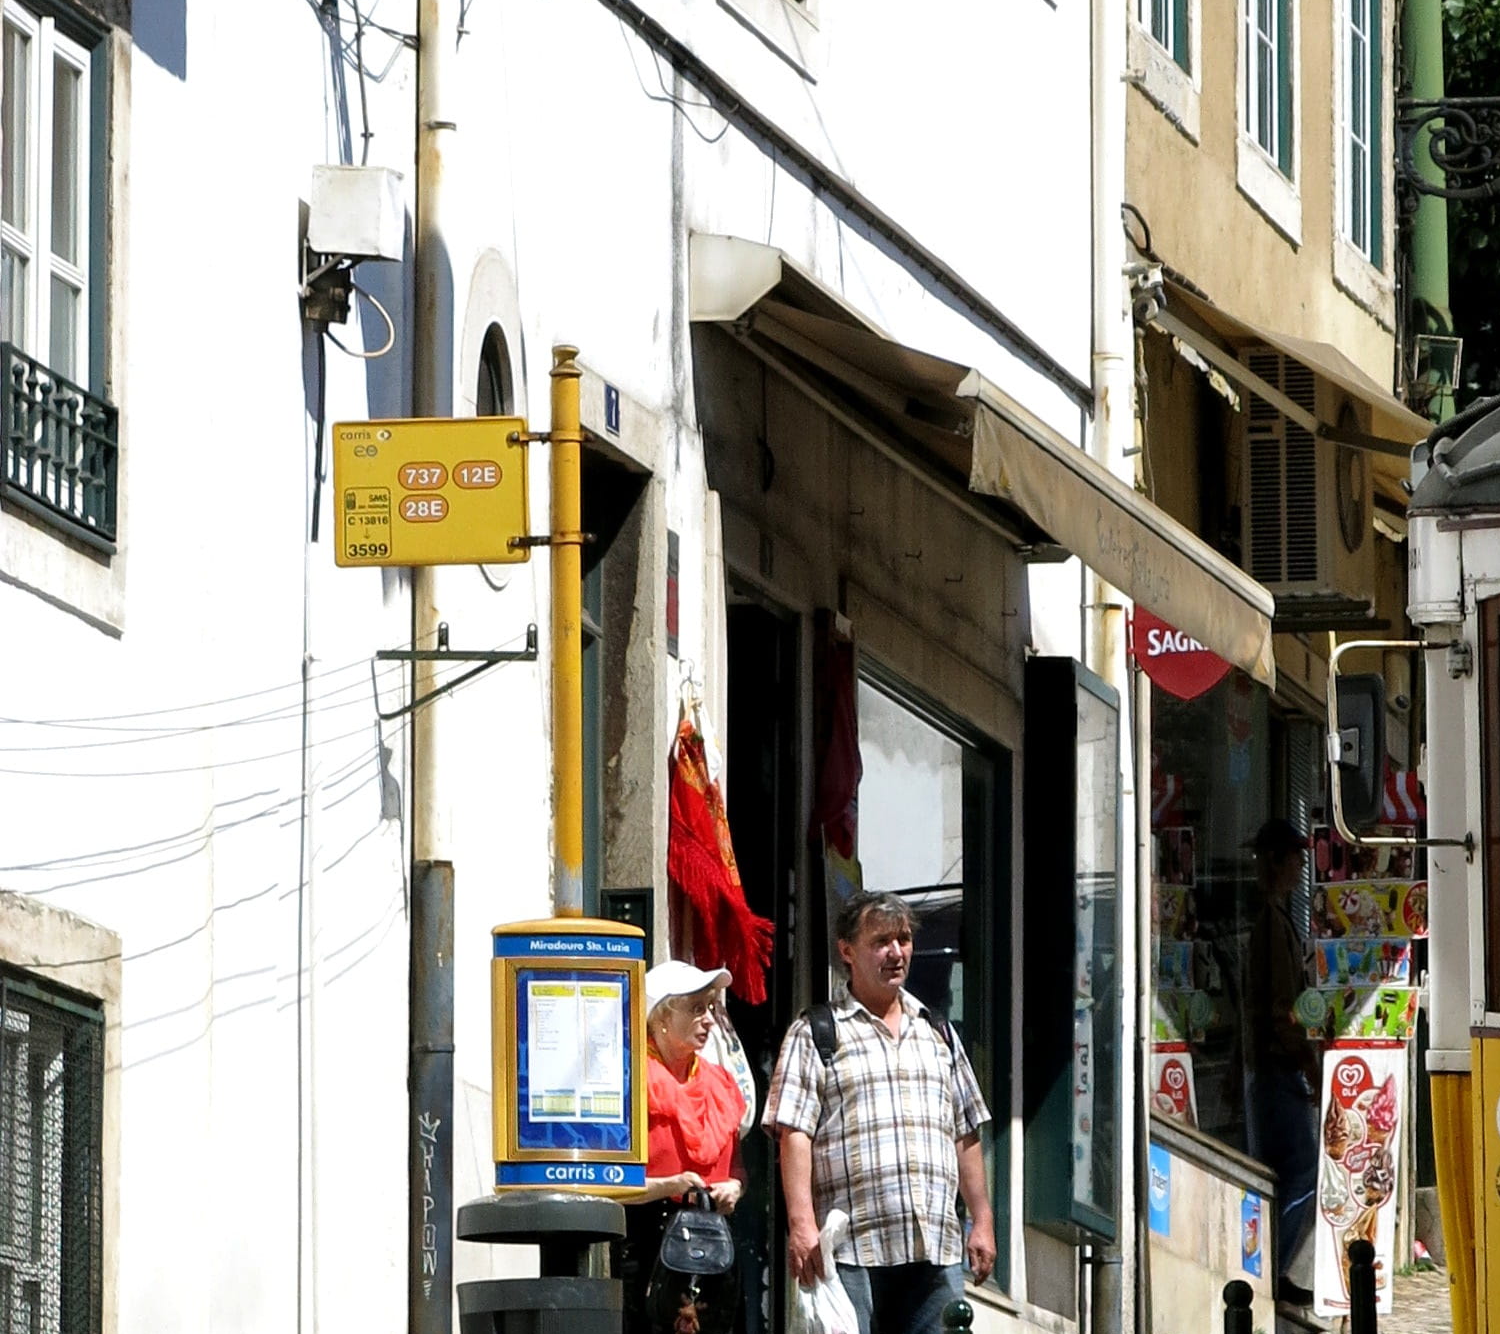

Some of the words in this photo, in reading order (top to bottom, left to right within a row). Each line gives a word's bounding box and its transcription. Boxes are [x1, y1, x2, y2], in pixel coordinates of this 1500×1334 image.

[340, 430, 371, 441] carris
[405, 468, 442, 484] 737
[461, 467, 496, 483] 12E
[406, 500, 443, 517] 28E
[348, 516, 356, 525] C
[348, 544, 388, 557] 3599
[530, 940, 583, 951] Miradouro
[606, 941, 630, 952] Luzia
[545, 1163, 596, 1180] carris
